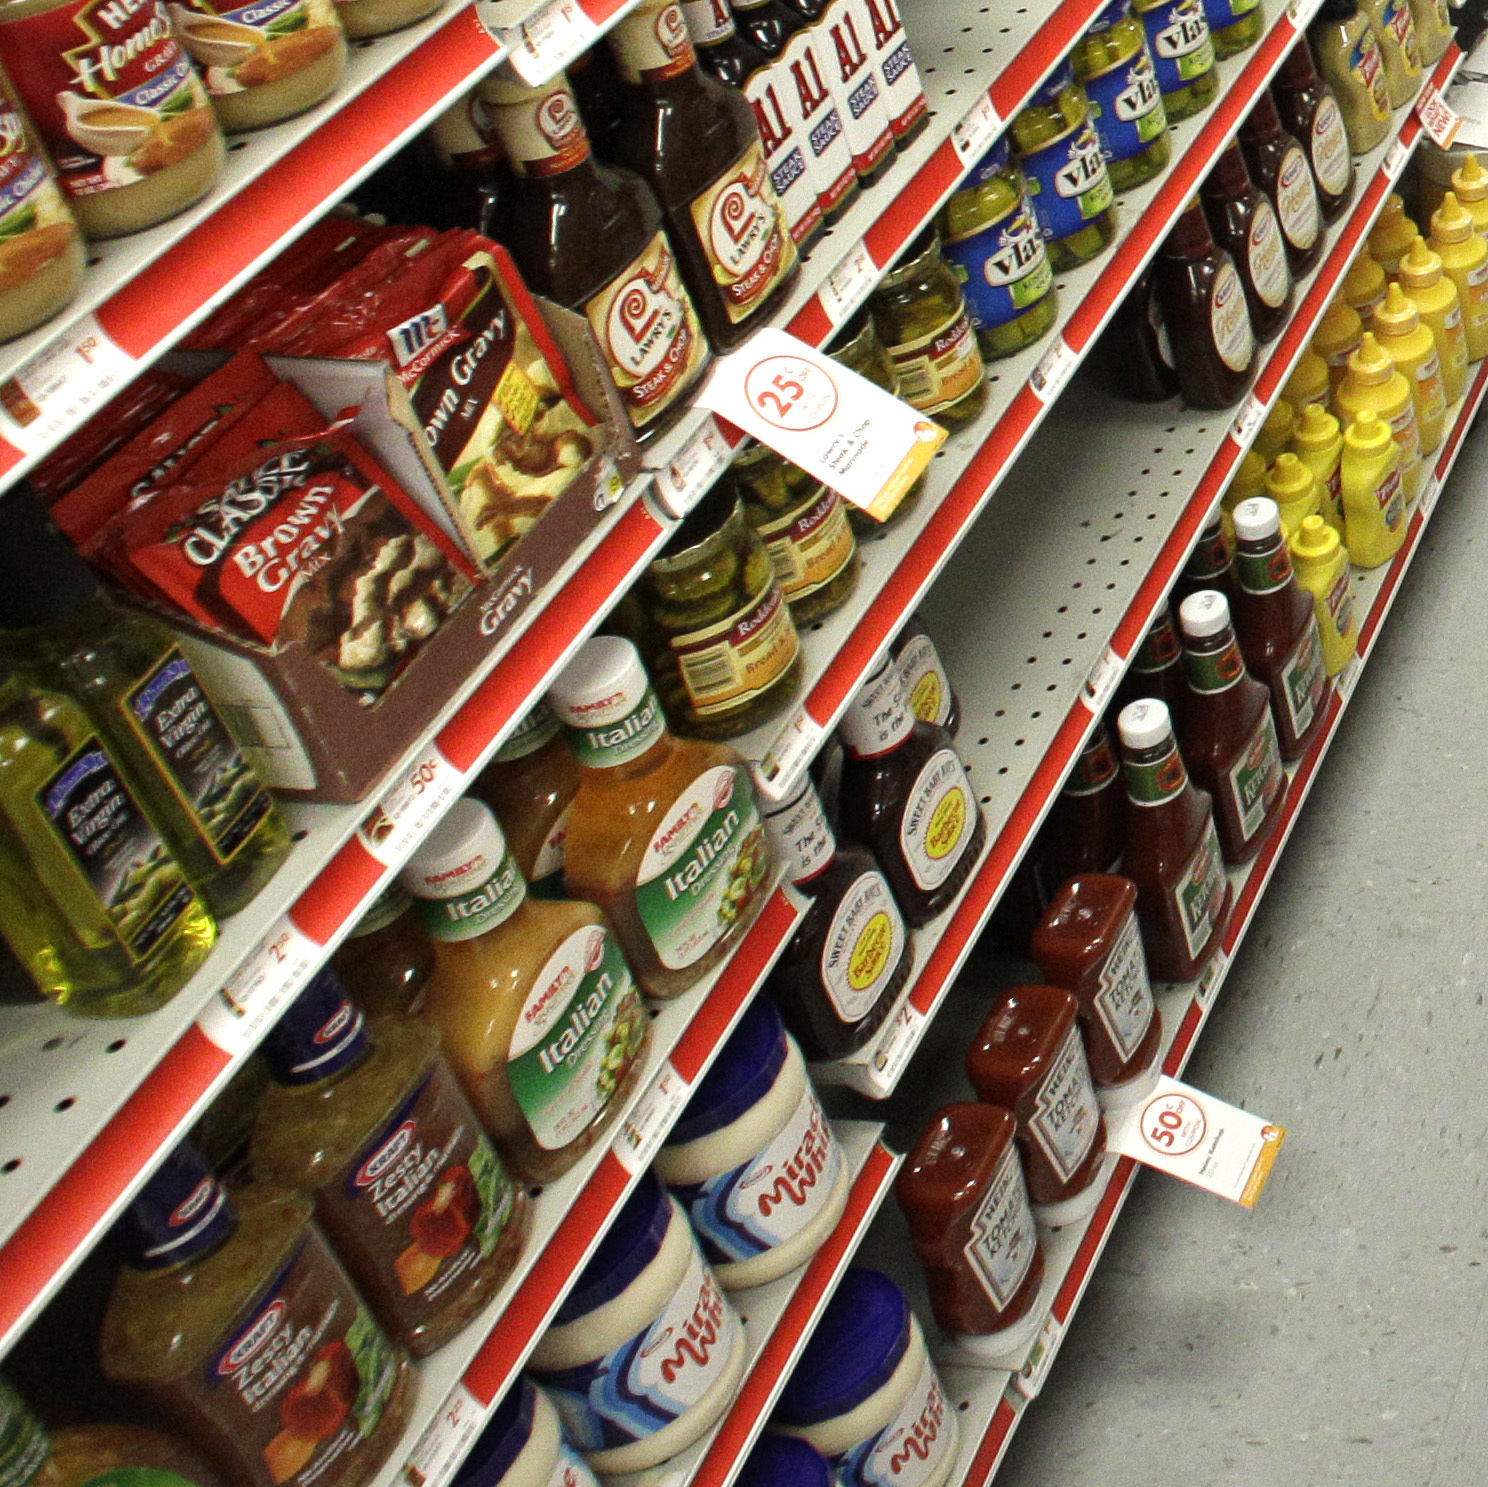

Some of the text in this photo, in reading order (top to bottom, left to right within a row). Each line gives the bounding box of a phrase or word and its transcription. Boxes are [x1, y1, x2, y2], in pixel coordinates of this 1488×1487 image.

[832, 10, 868, 84] A1
[791, 44, 829, 119] A1
[849, 74, 877, 106] STEAK
[809, 109, 842, 146] STEAK
[771, 148, 805, 181] STEAK
[426, 308, 508, 448] own Gravy
[757, 374, 805, 419] 25
[233, 484, 333, 577] Brown
[258, 506, 347, 594] Gravy
[481, 569, 534, 636] Gravy
[664, 809, 742, 901] Italian
[538, 972, 614, 1074] Italian
[1151, 1111, 1183, 1147] 50
[369, 1142, 424, 1202] Zesty
[234, 1323, 296, 1391] Zesty
